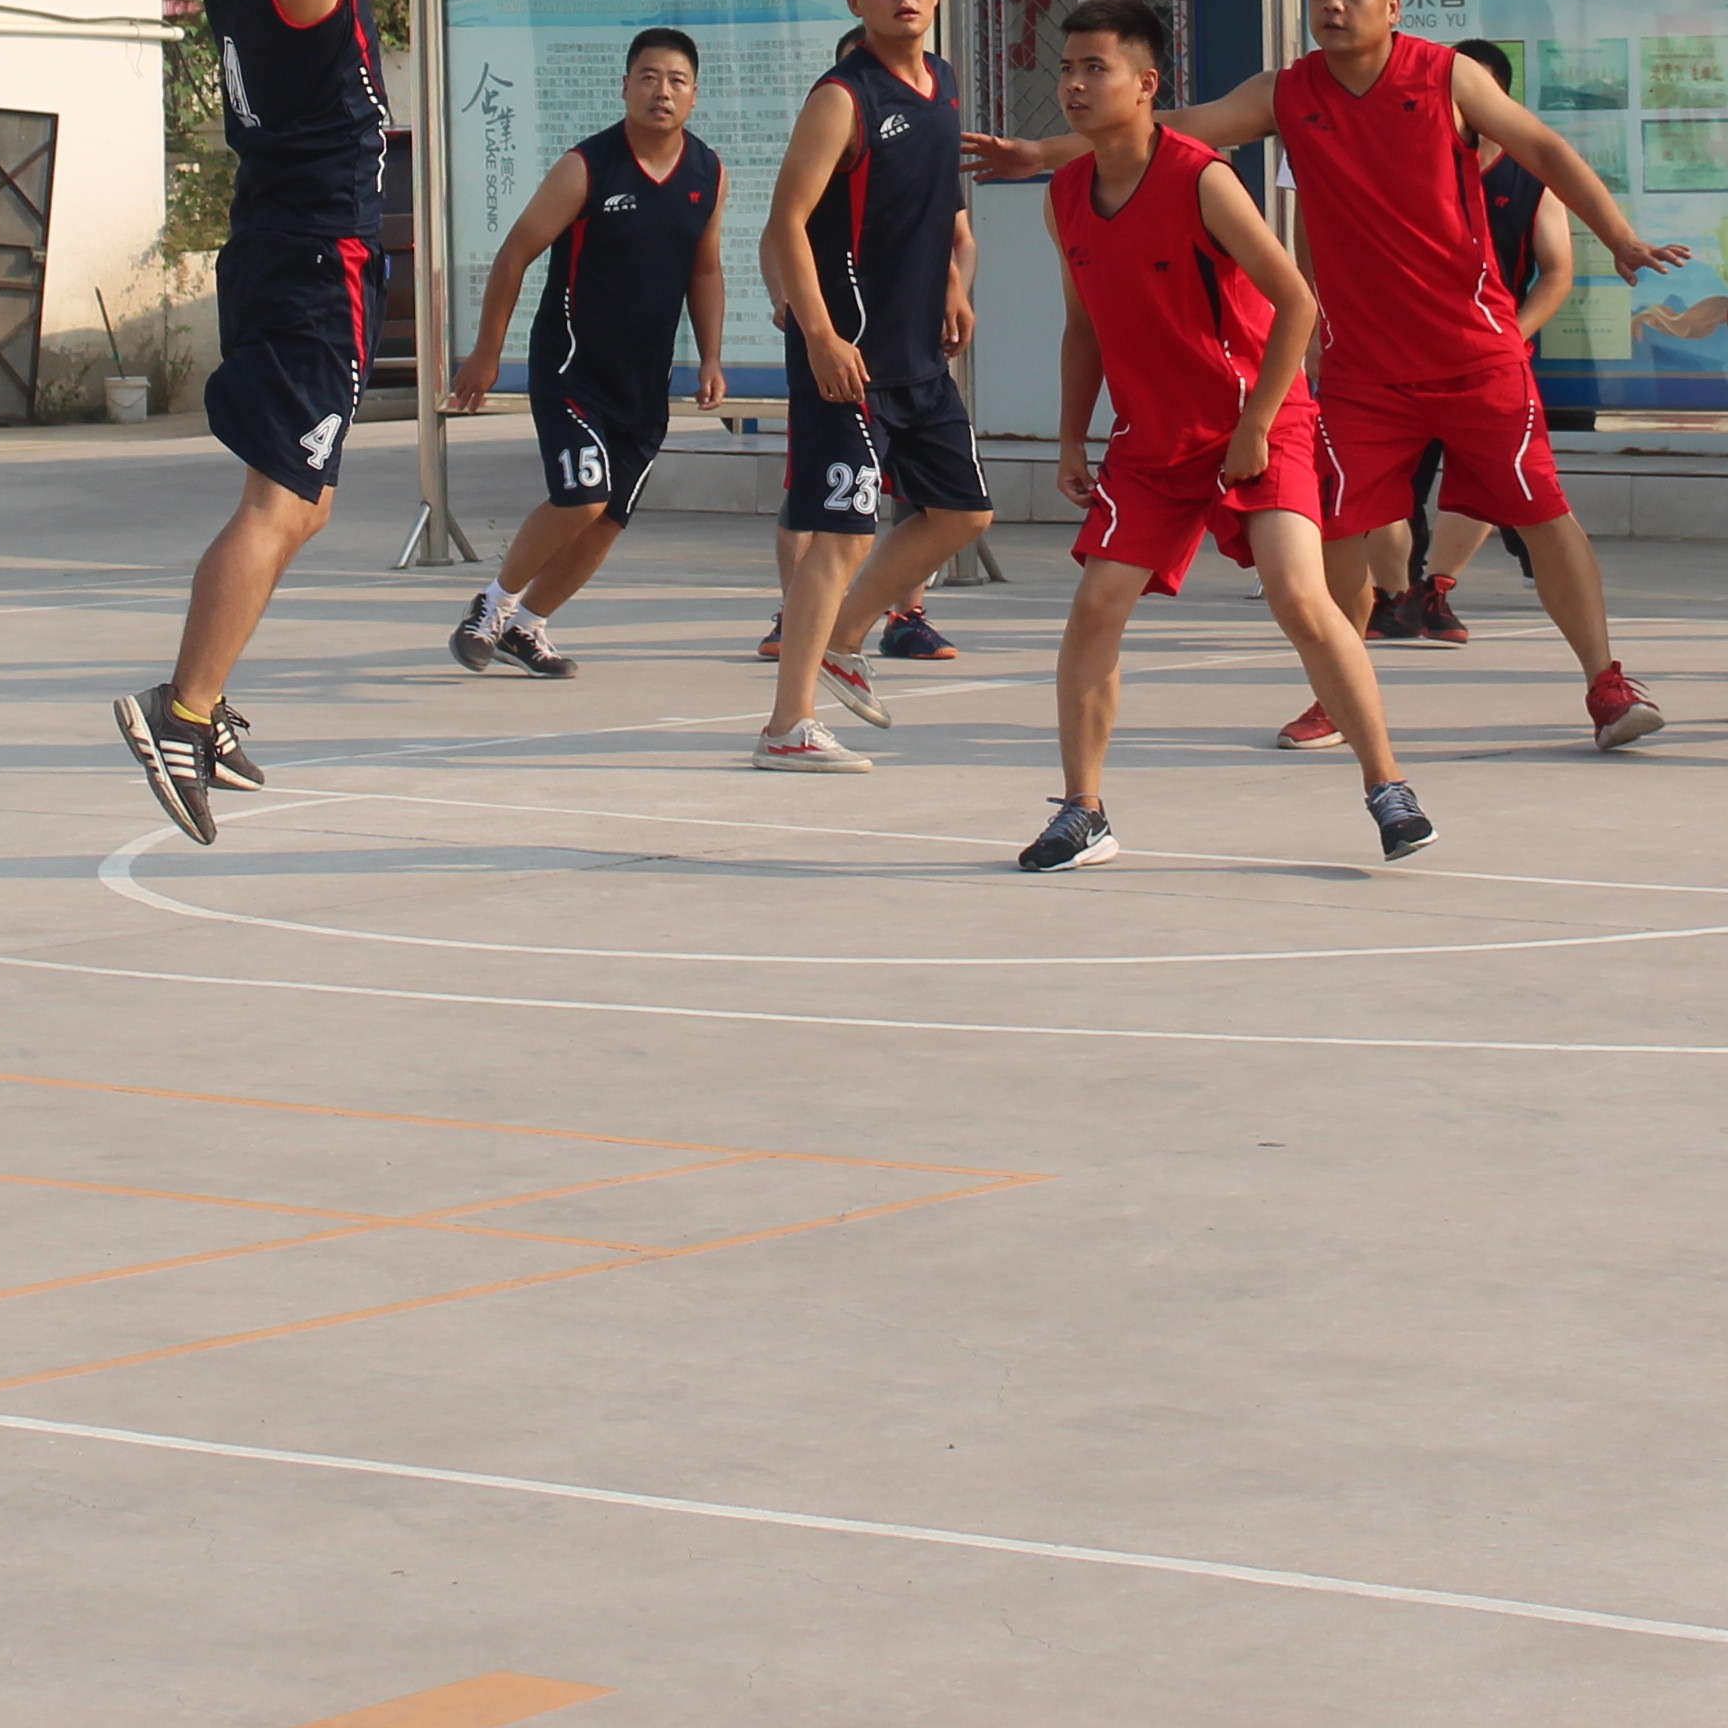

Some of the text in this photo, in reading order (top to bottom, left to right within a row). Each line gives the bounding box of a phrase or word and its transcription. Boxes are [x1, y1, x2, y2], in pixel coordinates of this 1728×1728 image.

[1446, 12, 1466, 27] YU
[485, 128, 500, 233] LAKE SCENIC
[299, 413, 342, 470] 4
[558, 445, 602, 489] 15
[824, 462, 877, 514] 23
